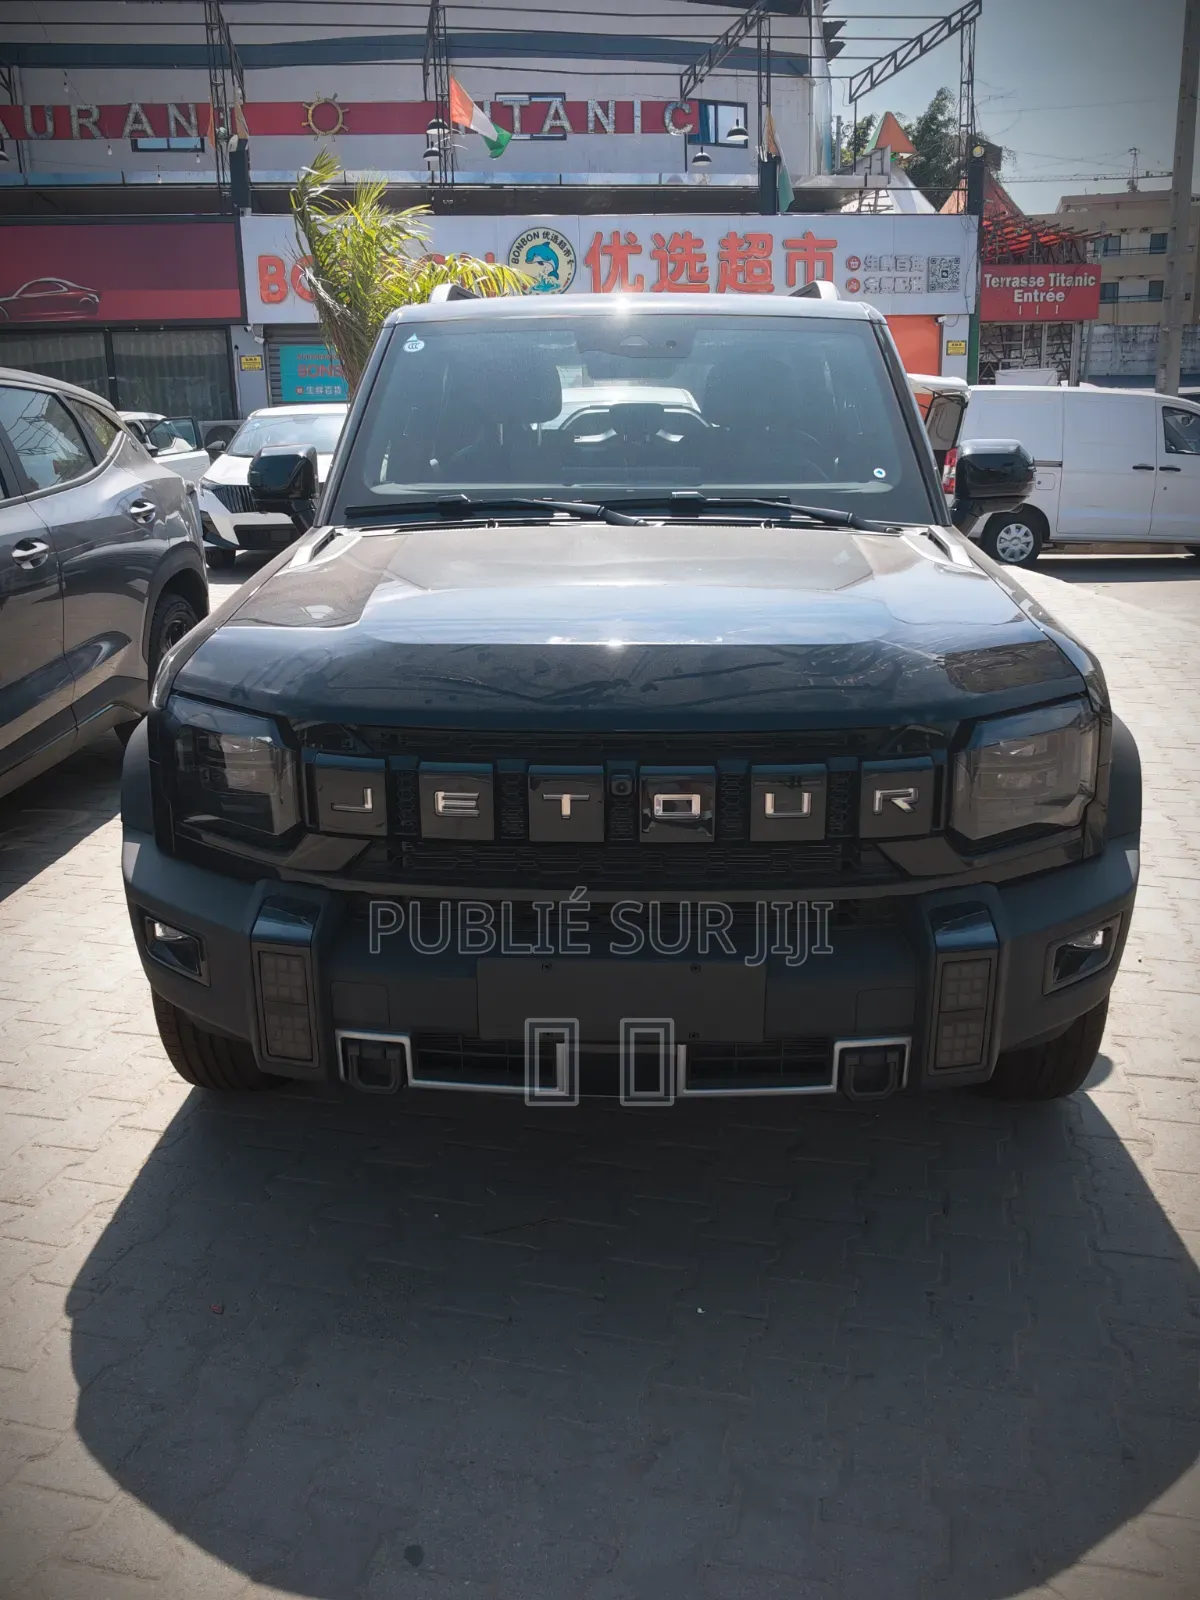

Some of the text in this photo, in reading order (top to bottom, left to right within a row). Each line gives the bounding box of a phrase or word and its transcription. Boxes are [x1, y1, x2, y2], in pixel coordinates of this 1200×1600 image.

[511, 231, 540, 265] BONBON
[583, 231, 838, 293] 优选超市
[984, 272, 1097, 289] Terrasse Titanic
[1013, 287, 1066, 303] Entrée
[330, 786, 919, 820] JETOUR
